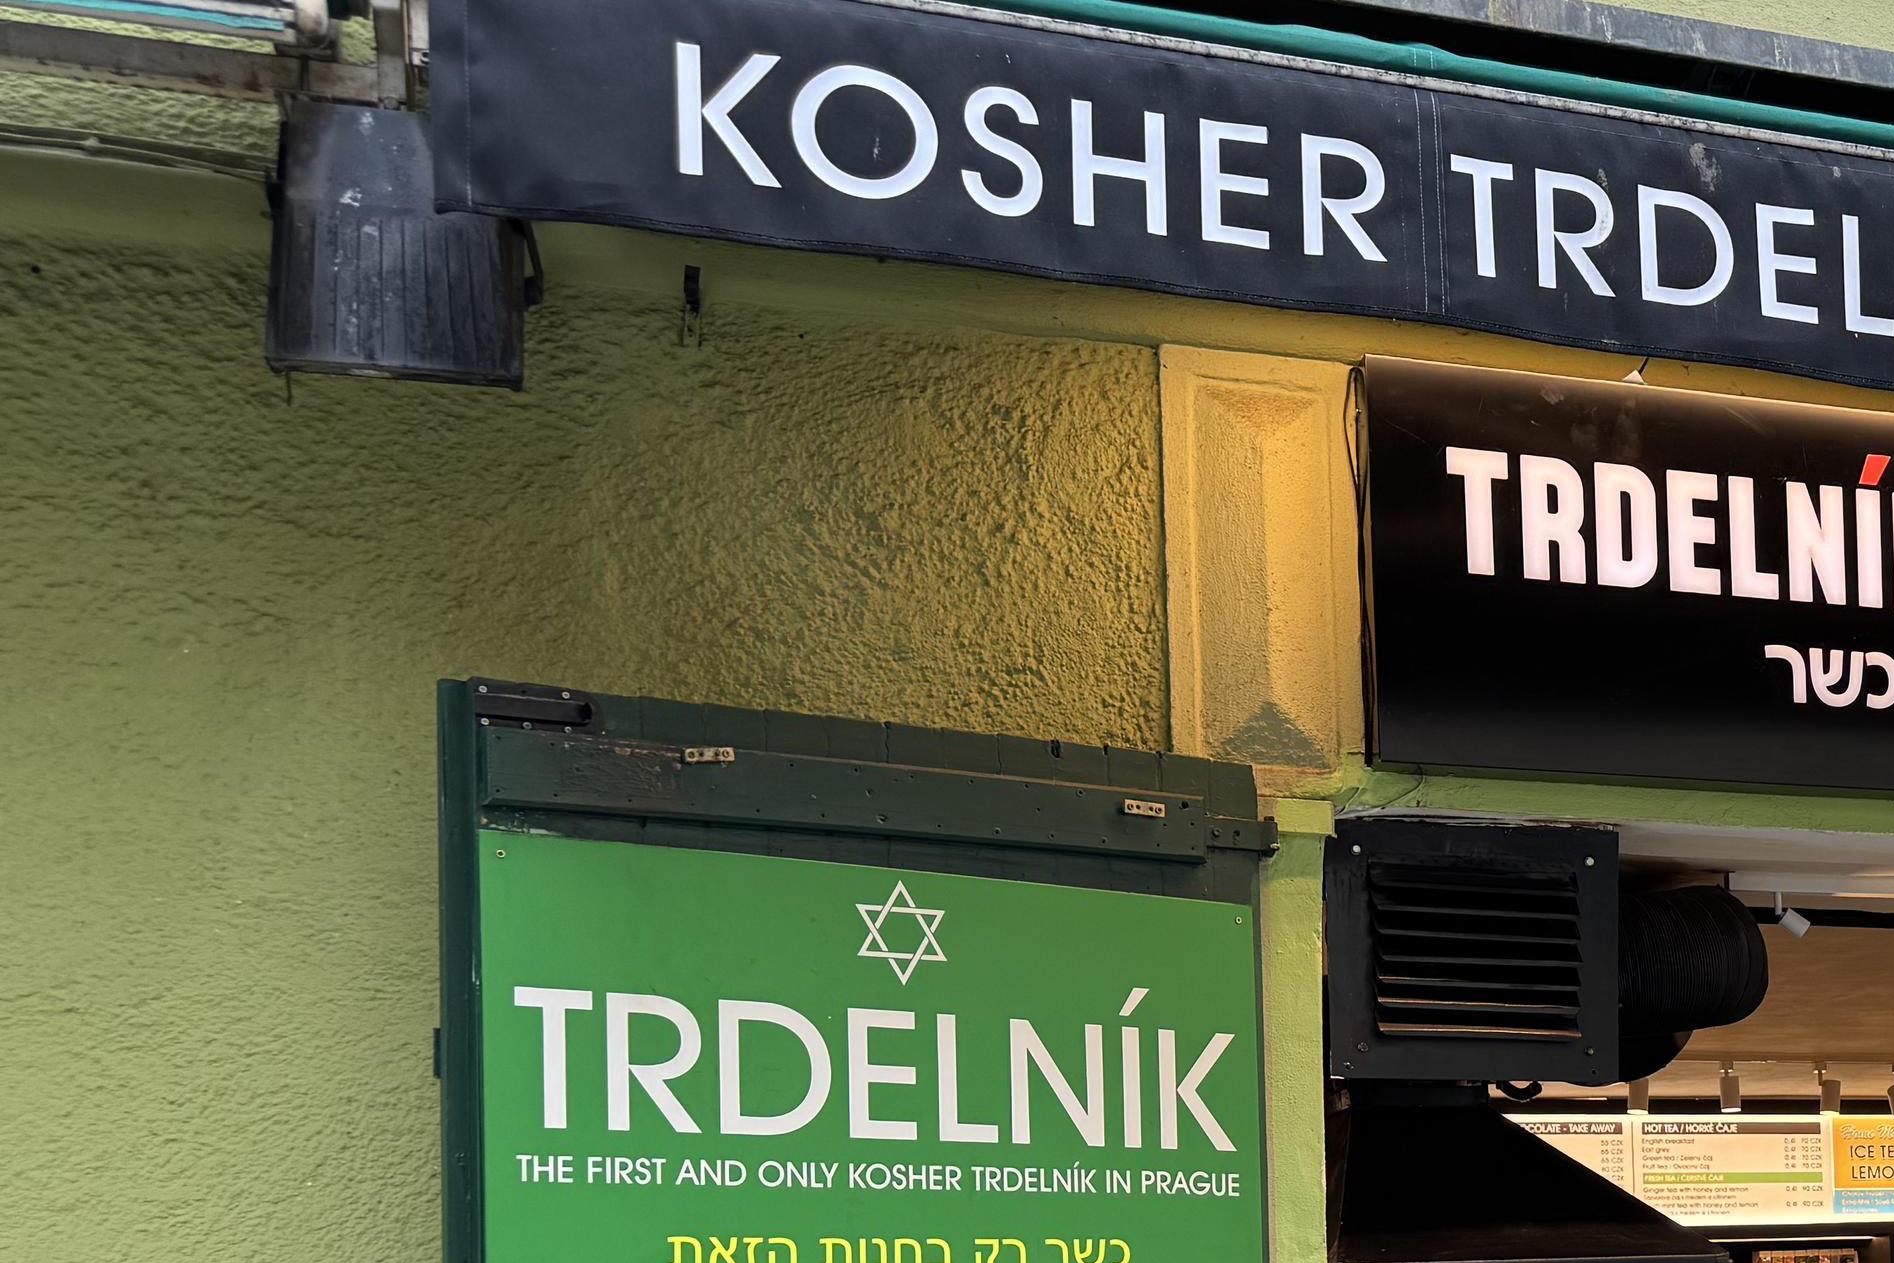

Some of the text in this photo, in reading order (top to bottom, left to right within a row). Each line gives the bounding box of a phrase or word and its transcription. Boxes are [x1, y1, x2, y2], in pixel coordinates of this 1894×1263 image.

[675, 41, 1387, 262] KOSHER
[514, 986, 1238, 1152] TRDELNÍK
[1644, 1124, 1662, 1133] HOT
[1664, 1124, 1678, 1133] TEA
[1850, 1145, 1874, 1158] ICE
[516, 1155, 1240, 1198] THE FIRST AND ONLY KOSHER TRDELNÍK IN PRAGUE
